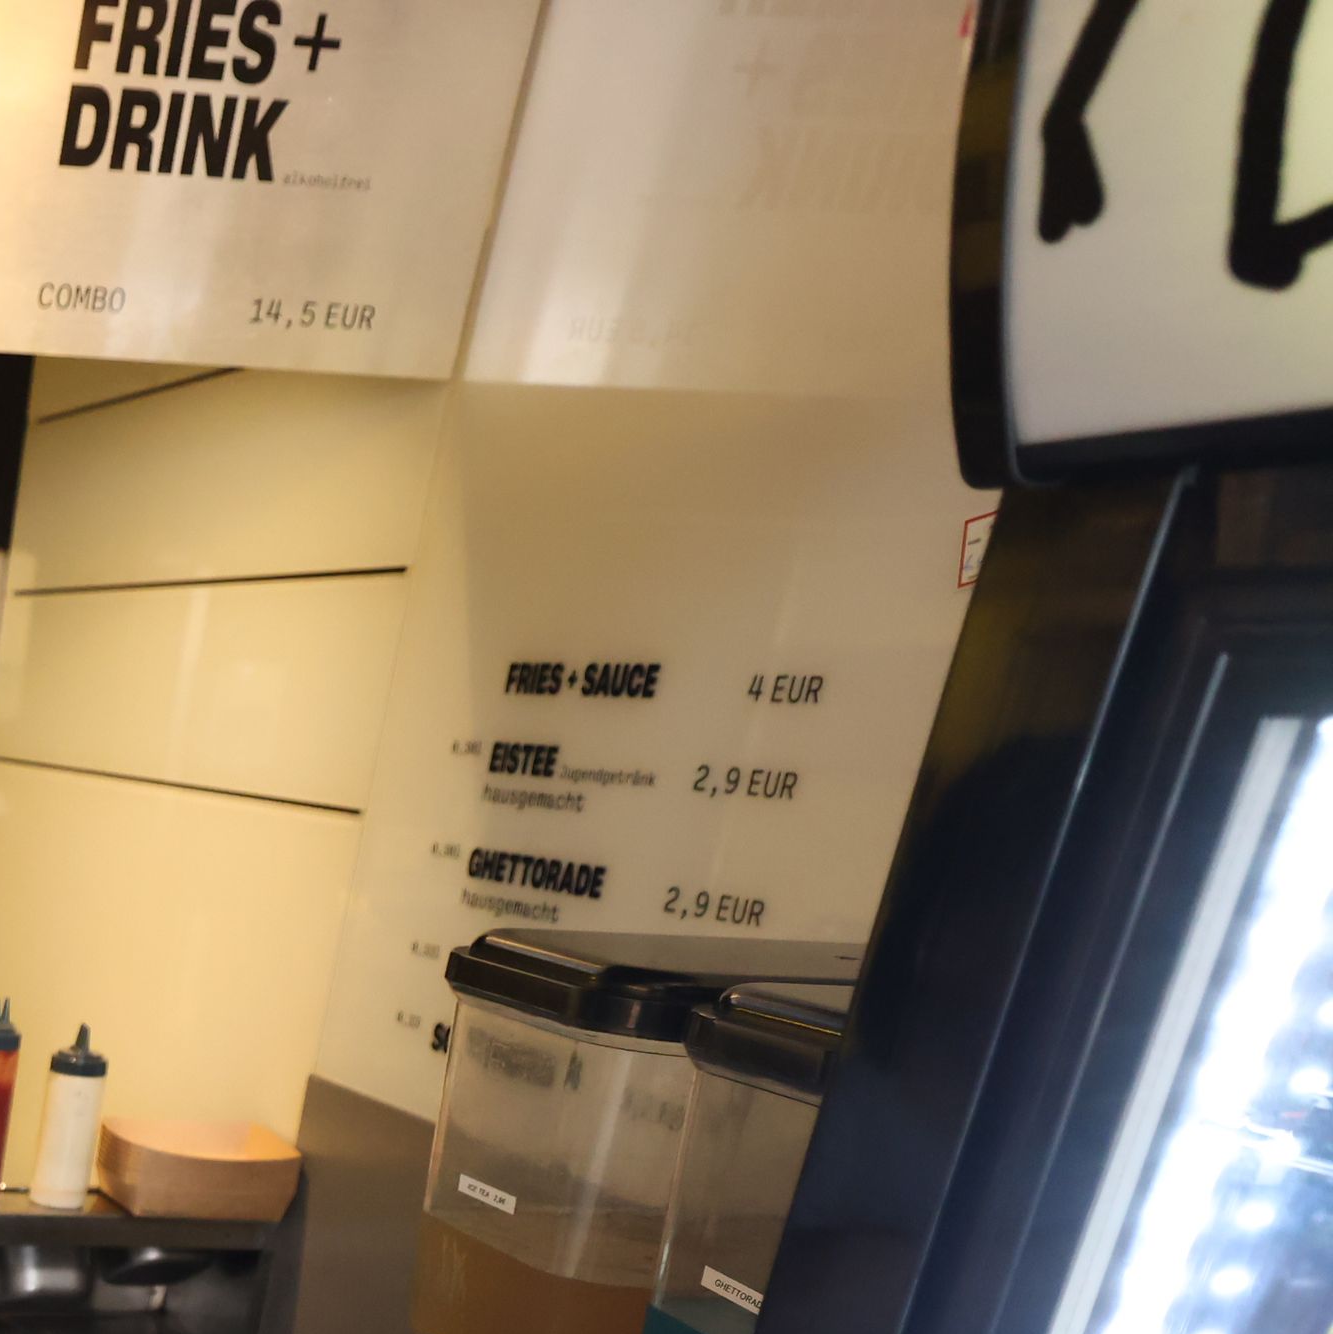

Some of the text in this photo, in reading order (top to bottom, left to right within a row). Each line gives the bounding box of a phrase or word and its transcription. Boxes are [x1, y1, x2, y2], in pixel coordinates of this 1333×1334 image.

[59, 85, 290, 183] DRINK
[37, 282, 126, 315] COMBO
[248, 298, 377, 332] 14,5 EUR
[504, 661, 566, 696] FRIES
[580, 661, 662, 700] SAUCE
[747, 674, 825, 704] 4 EUR
[489, 741, 561, 778] EISTEE
[481, 782, 586, 814] hausgemacht
[692, 764, 799, 801] 2,9 EUR
[466, 846, 608, 901] GHETTORADE
[460, 886, 562, 924] hausgemacht
[662, 885, 766, 928] 2,9 EUR
[714, 1279, 763, 1308] GHETTORAD
